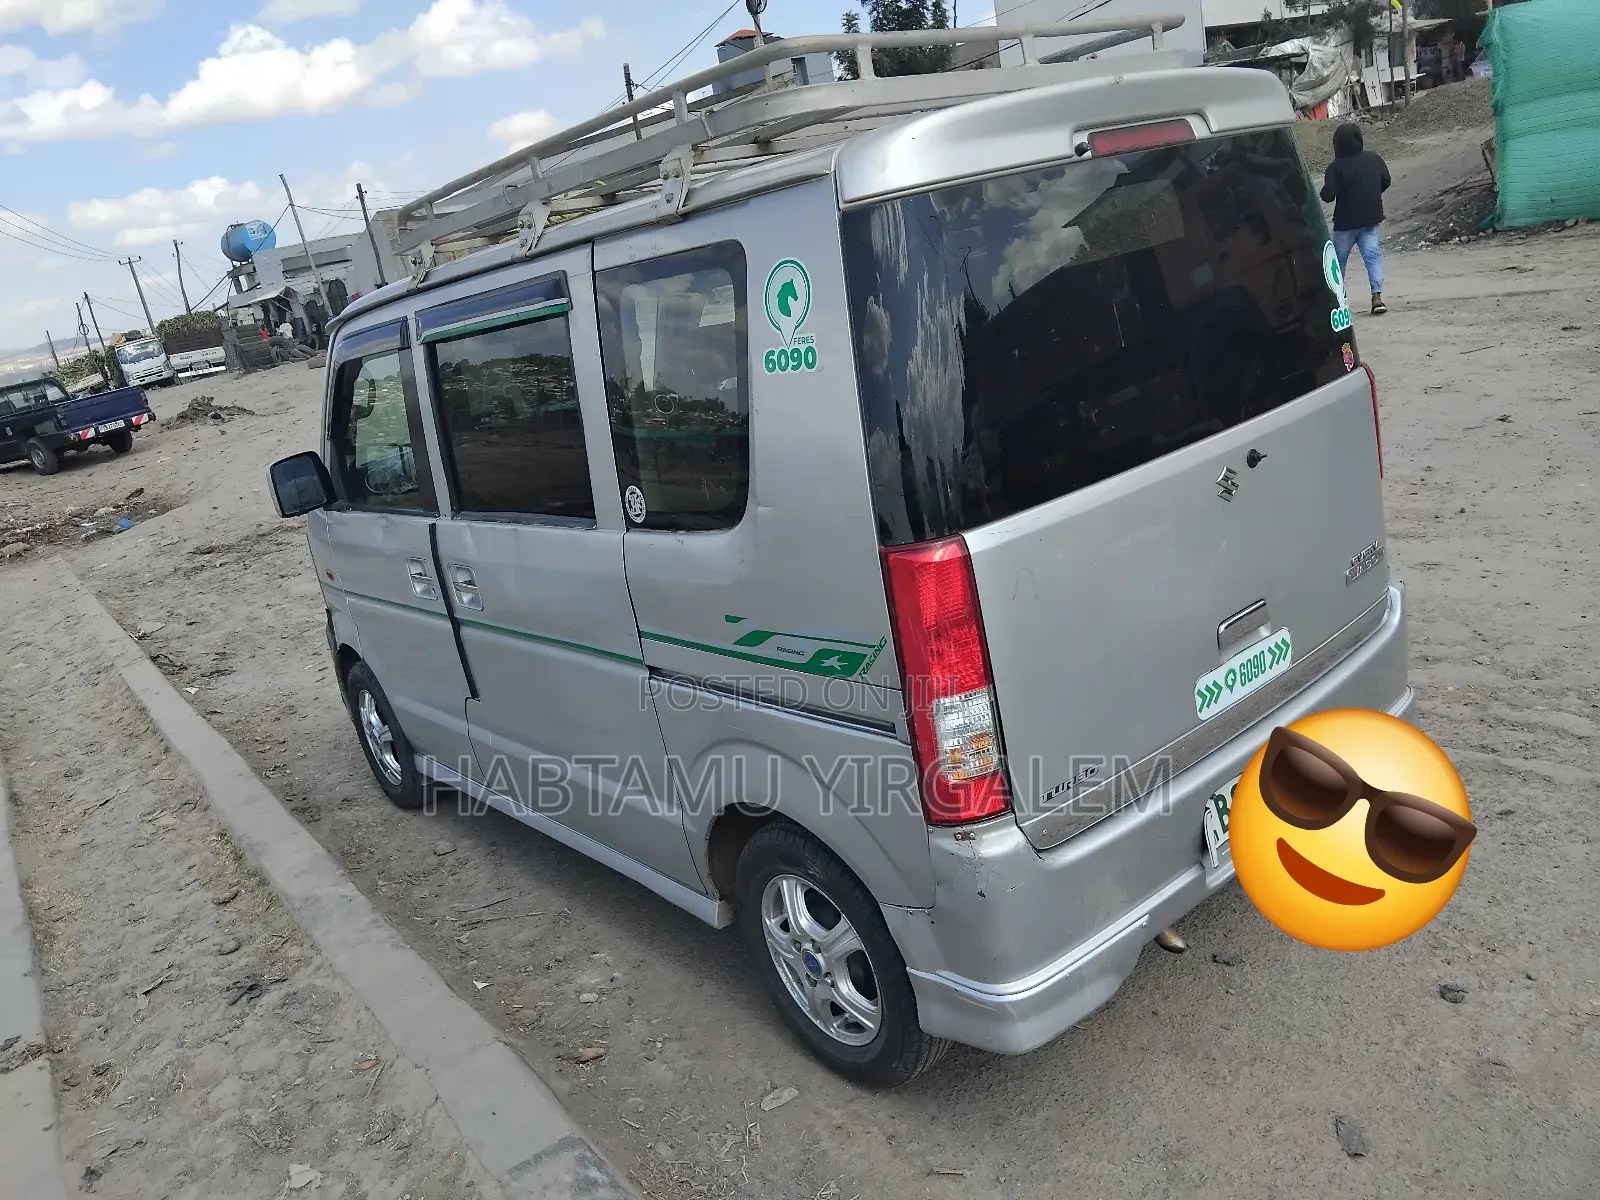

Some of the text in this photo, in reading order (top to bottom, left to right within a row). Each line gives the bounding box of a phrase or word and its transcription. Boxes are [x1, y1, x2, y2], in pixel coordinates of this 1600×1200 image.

[1332, 308, 1352, 330] 609
[793, 335, 815, 346] FERES
[764, 346, 817, 373] 6090
[858, 635, 888, 680] RACING
[1239, 650, 1267, 687] 6090
[1039, 763, 1100, 803] TURBO
